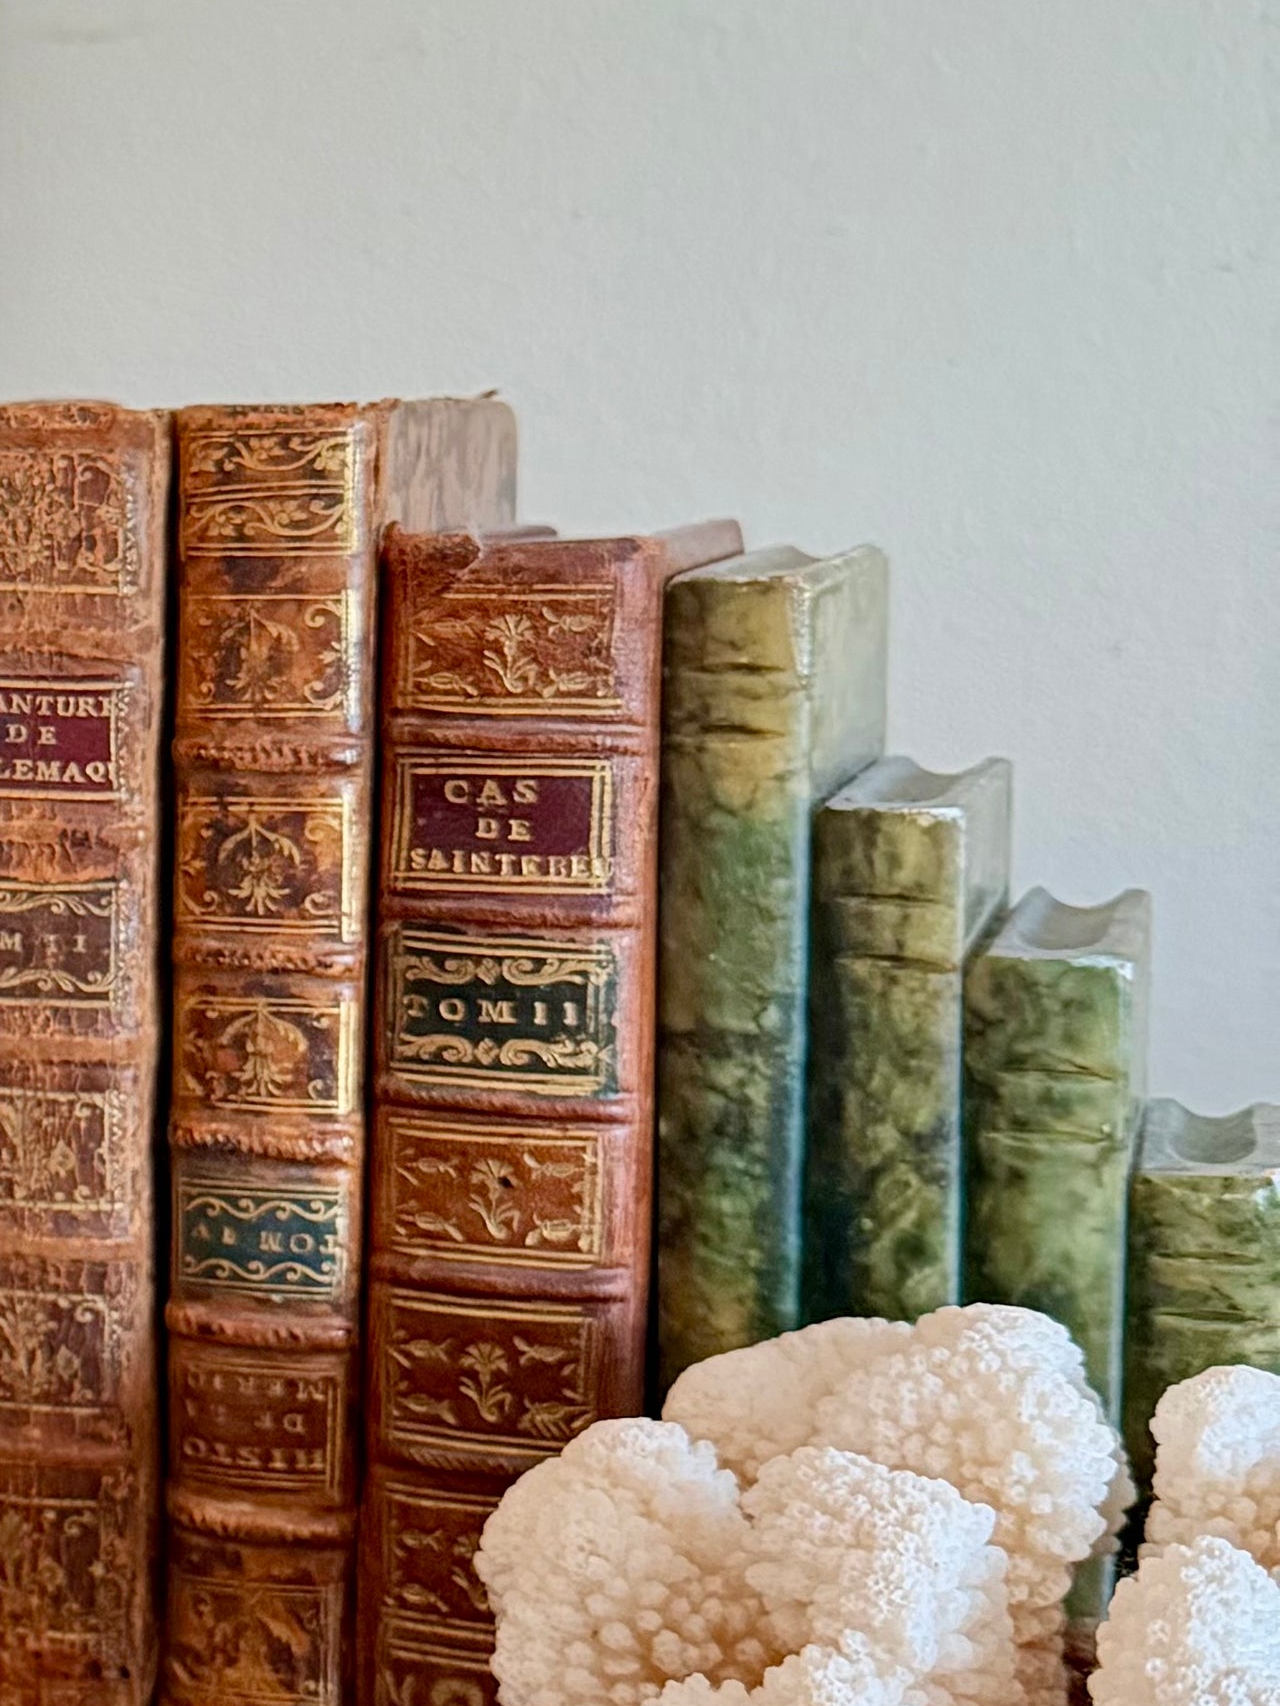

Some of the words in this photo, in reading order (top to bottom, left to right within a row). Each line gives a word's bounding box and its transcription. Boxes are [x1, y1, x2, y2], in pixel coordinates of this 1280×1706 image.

[4, 723, 58, 746] DE
[443, 779, 539, 806] CAS
[475, 817, 532, 842] DE
[259, 1229, 339, 1255] TOM
